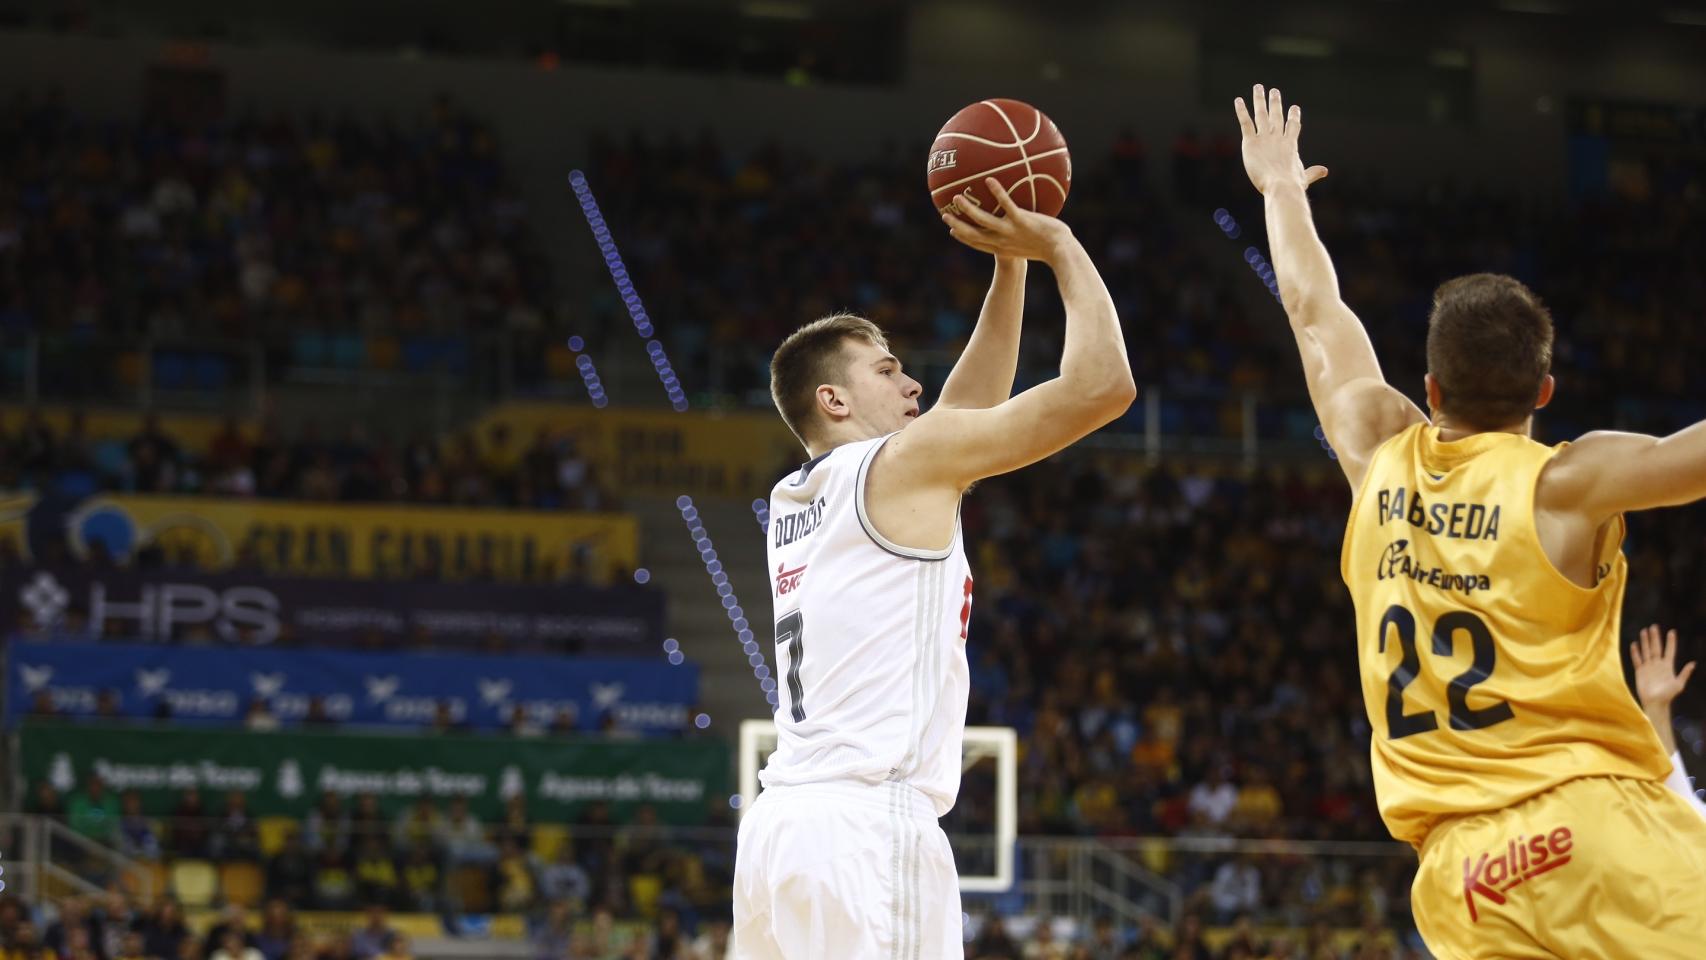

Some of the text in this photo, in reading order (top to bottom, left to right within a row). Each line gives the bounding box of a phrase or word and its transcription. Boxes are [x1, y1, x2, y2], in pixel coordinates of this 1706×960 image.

[91, 582, 281, 645] HPS
[775, 607, 807, 723] 7
[1378, 604, 1515, 740] 22
[1463, 826, 1573, 923] Kalise
